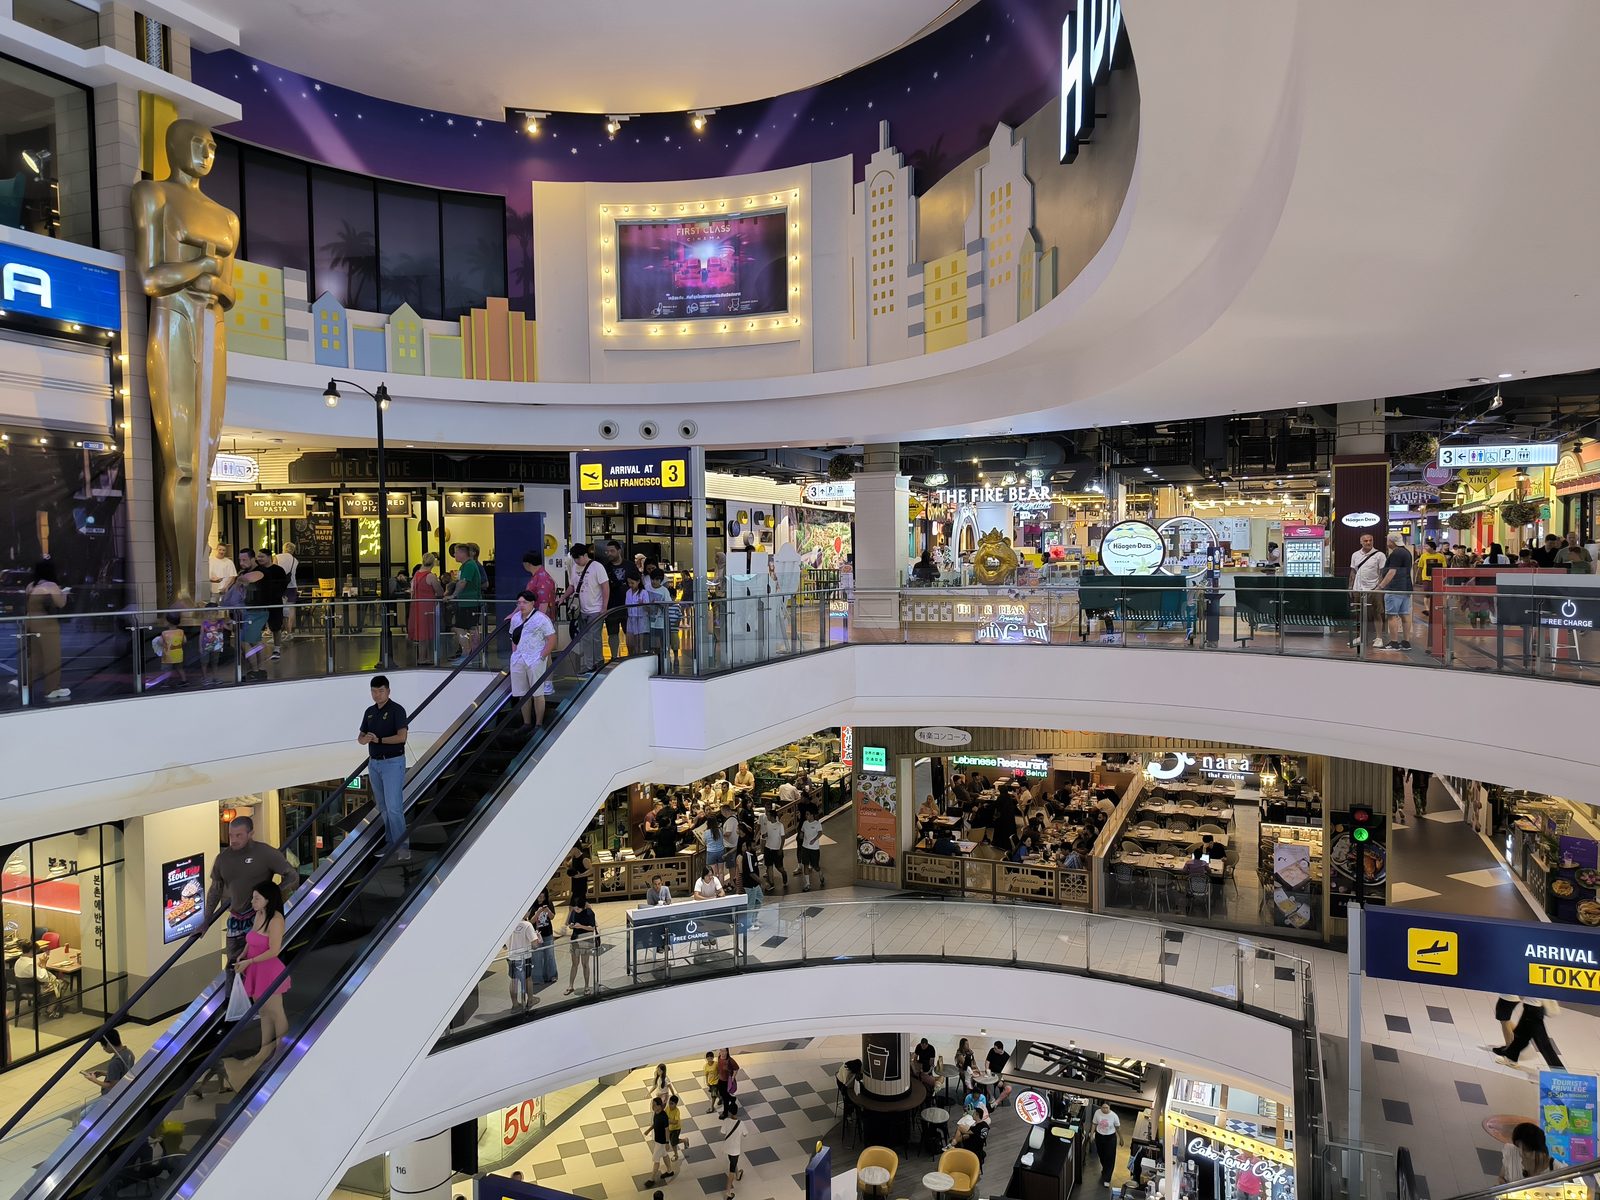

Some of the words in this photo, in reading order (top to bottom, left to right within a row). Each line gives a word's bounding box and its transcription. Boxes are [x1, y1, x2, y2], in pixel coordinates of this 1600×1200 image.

[676, 227, 701, 236] FIRST
[703, 225, 731, 234] CLASS
[1443, 450, 1453, 464] 3
[1504, 449, 1511, 457] P
[330, 461, 411, 477] WELCME
[610, 465, 640, 475] ARRIVAL
[644, 464, 654, 474] AT
[668, 465, 678, 482] 3
[603, 479, 619, 488] SAN
[620, 477, 660, 488] FRANCISCO
[1469, 476, 1488, 484] XING
[811, 486, 817, 497] 3
[936, 488, 967, 504] THE
[971, 486, 1004, 503] FIRE
[1009, 485, 1052, 501] BEAR
[1393, 491, 1432, 502] HAIGHT
[1563, 619, 1593, 627] CHARGE
[953, 756, 997, 767] Lebanese
[997, 757, 1048, 770] Restaurant
[1202, 756, 1249, 771] nara
[1015, 768, 1025, 777] By
[1026, 769, 1048, 778] Beirut
[168, 871, 188, 883] SEOUL
[687, 932, 709, 940] CHARGE
[1524, 943, 1598, 964] ARRIVAL
[1551, 1085, 1587, 1093] PRIVILEGE
[1188, 1137, 1219, 1160] Cake
[1219, 1150, 1250, 1171] Land
[1252, 1161, 1288, 1185] Cafe
[396, 1166, 407, 1175] 116
